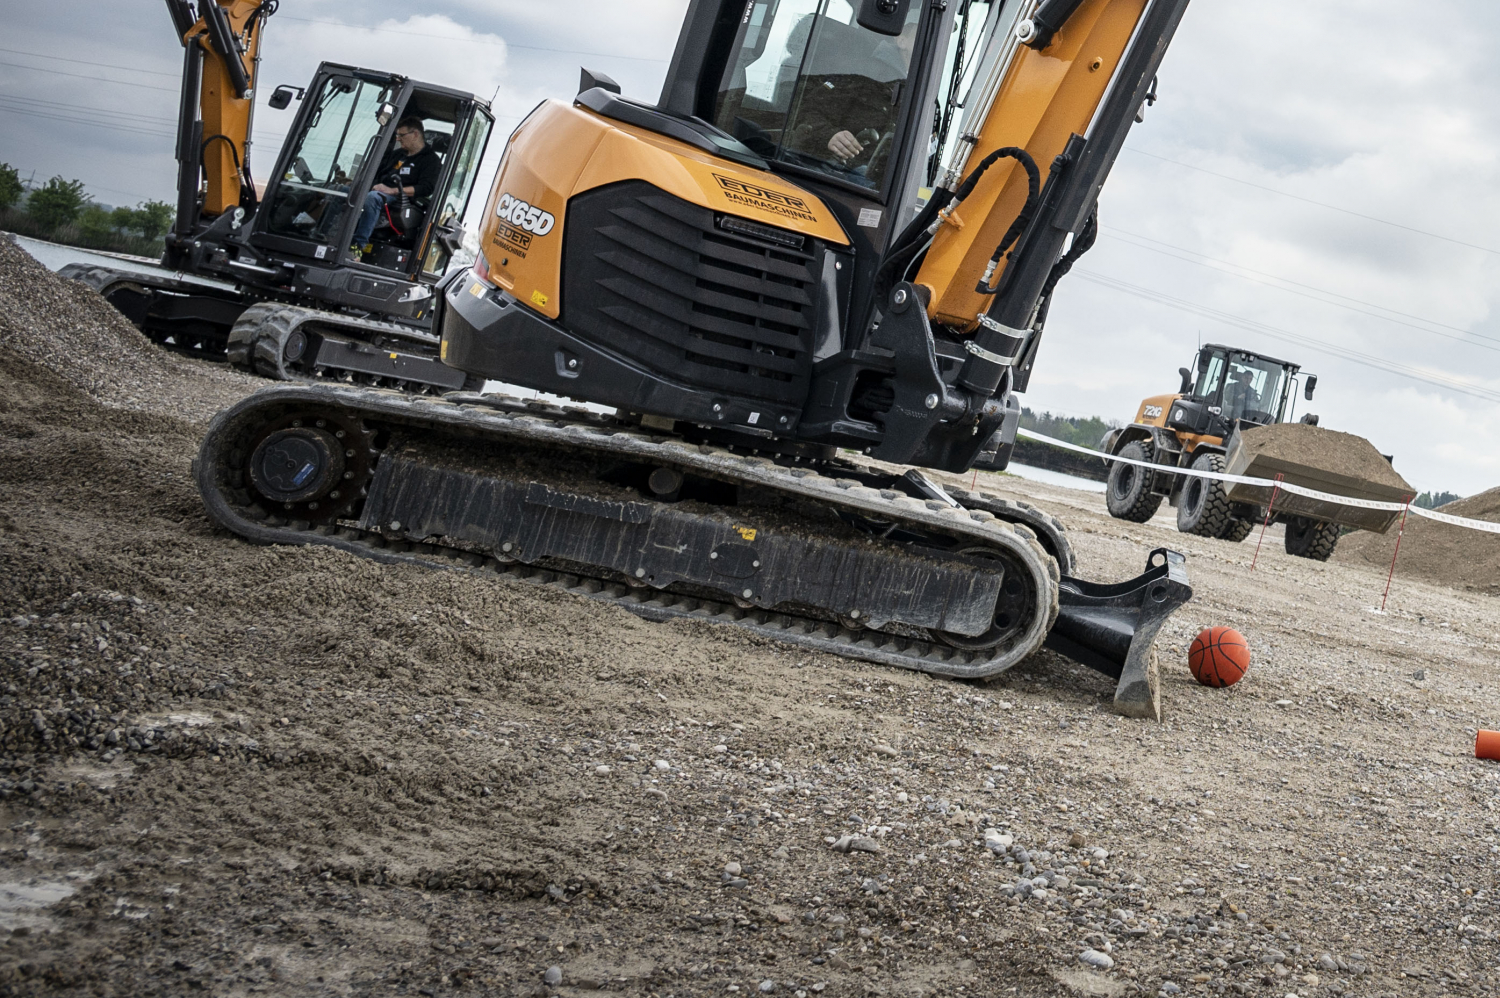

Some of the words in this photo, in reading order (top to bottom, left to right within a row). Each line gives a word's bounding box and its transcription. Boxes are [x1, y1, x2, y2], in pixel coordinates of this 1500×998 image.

[720, 178, 804, 210] EDER
[724, 191, 818, 222] BAUMASCHINEN
[496, 192, 555, 237] CX65D
[492, 237, 527, 259] BAUMASCHINEN
[498, 225, 531, 247] EDER
